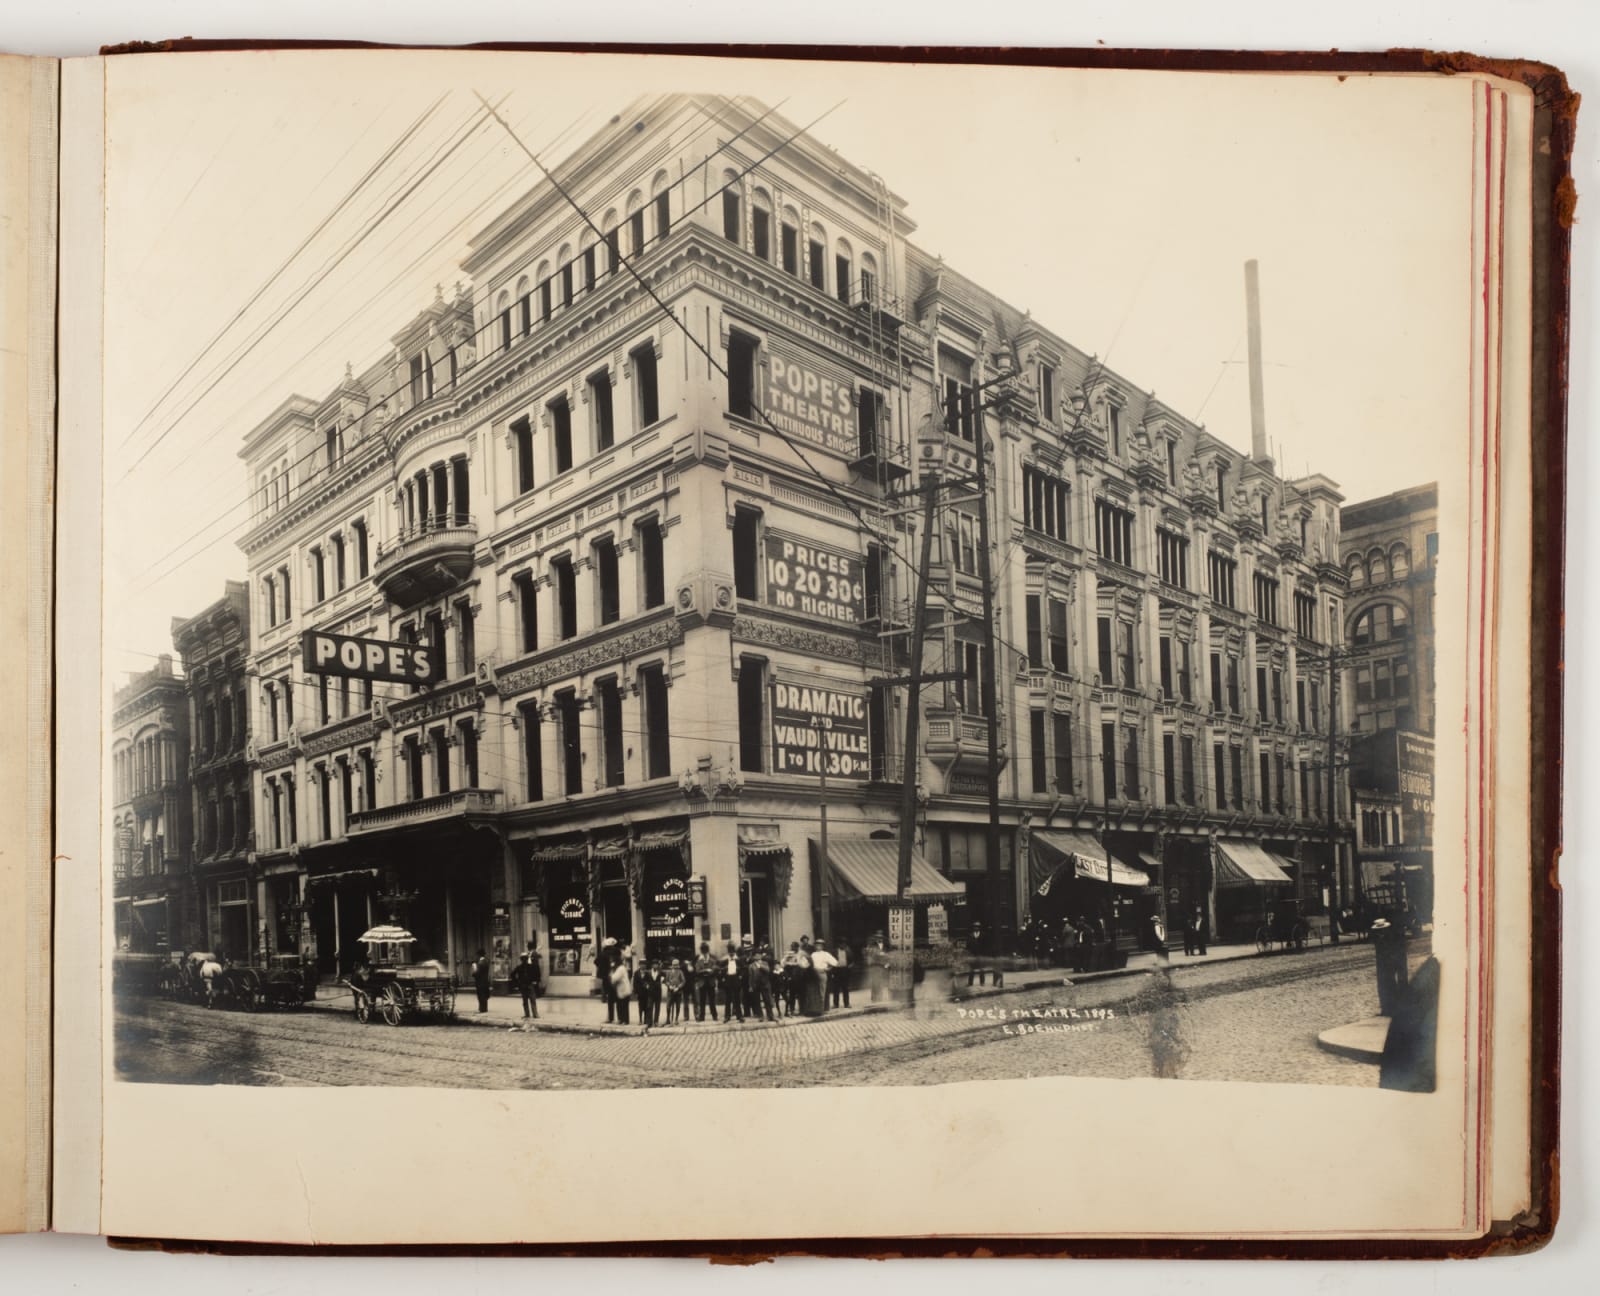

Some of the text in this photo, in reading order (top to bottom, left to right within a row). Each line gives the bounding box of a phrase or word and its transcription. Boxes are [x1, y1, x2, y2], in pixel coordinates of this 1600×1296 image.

[770, 355, 851, 415] POPE'S
[764, 409, 823, 443] CONTINUOUS
[769, 386, 854, 438] THEATRE
[783, 541, 849, 576] PRICES
[768, 558, 788, 586] 10
[795, 566, 820, 595] 20
[776, 589, 795, 608] NO
[316, 636, 431, 678] POPE'S
[776, 684, 864, 719] DRAMATIC
[655, 892, 688, 902] MERCANTIL
